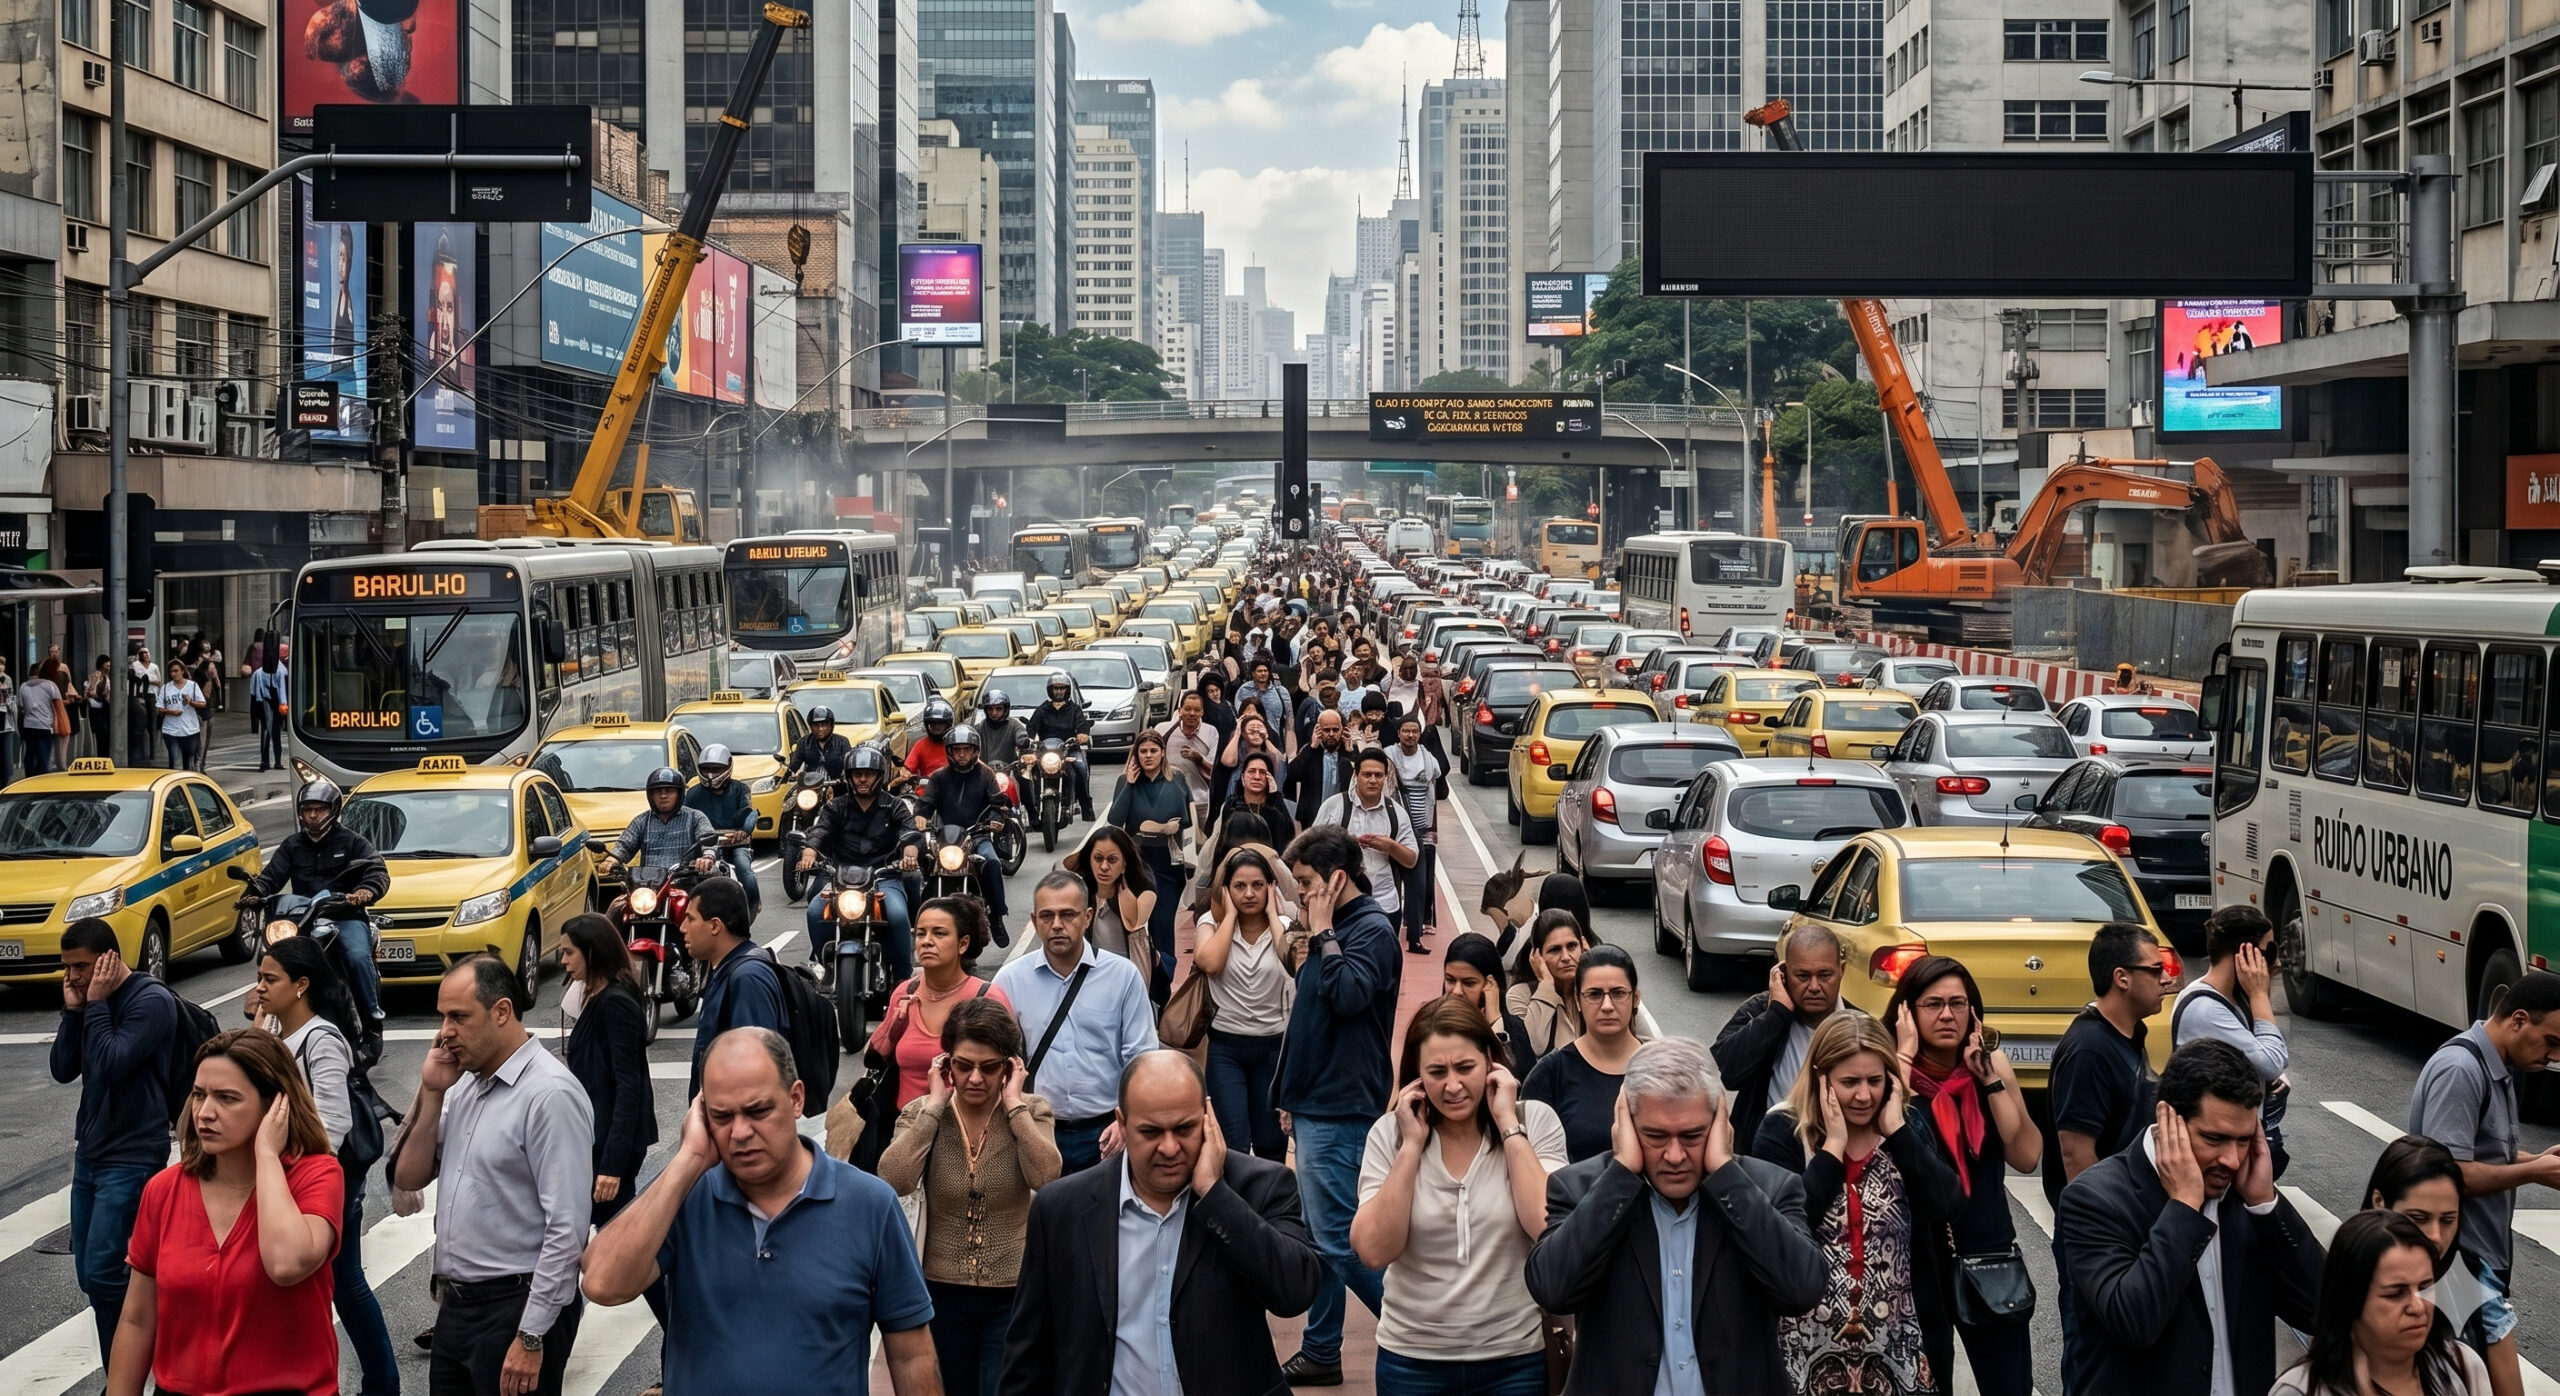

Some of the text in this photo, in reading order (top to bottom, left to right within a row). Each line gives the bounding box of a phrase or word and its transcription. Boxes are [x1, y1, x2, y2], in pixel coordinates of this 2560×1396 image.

[353, 573, 466, 598] BARULHO
[330, 711, 401, 728] BARULHO
[2314, 807, 2453, 901] RUÍDO URBANO
